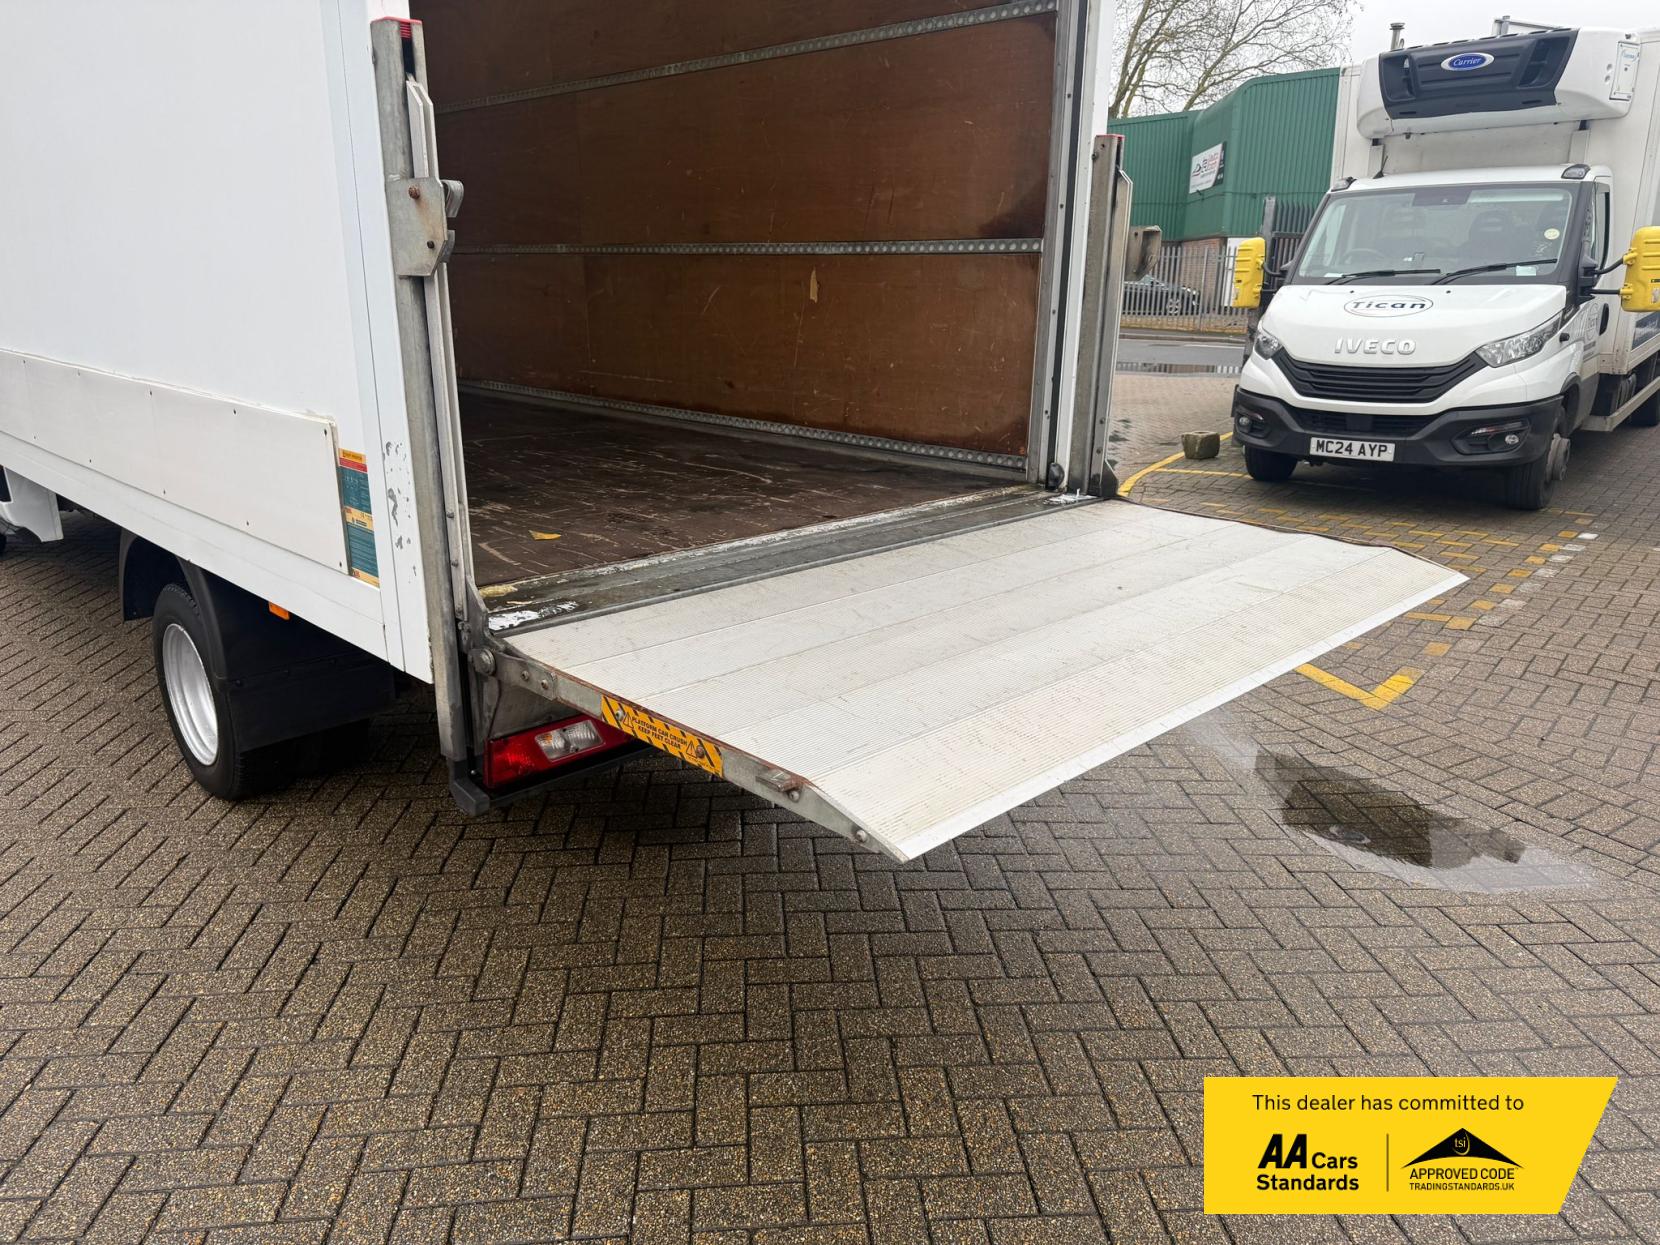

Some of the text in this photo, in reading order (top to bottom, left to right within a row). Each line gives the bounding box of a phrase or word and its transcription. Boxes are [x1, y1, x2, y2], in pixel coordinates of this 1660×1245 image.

[1453, 57, 1482, 67] Carrier
[1352, 301, 1426, 309] Tican
[1333, 337, 1417, 355] IVECO
[1316, 439, 1388, 458] MC24 AYP
[632, 716, 688, 746] PLATFORM CAN CRUSH
[638, 725, 681, 749] KEEP FEET CLEAR
